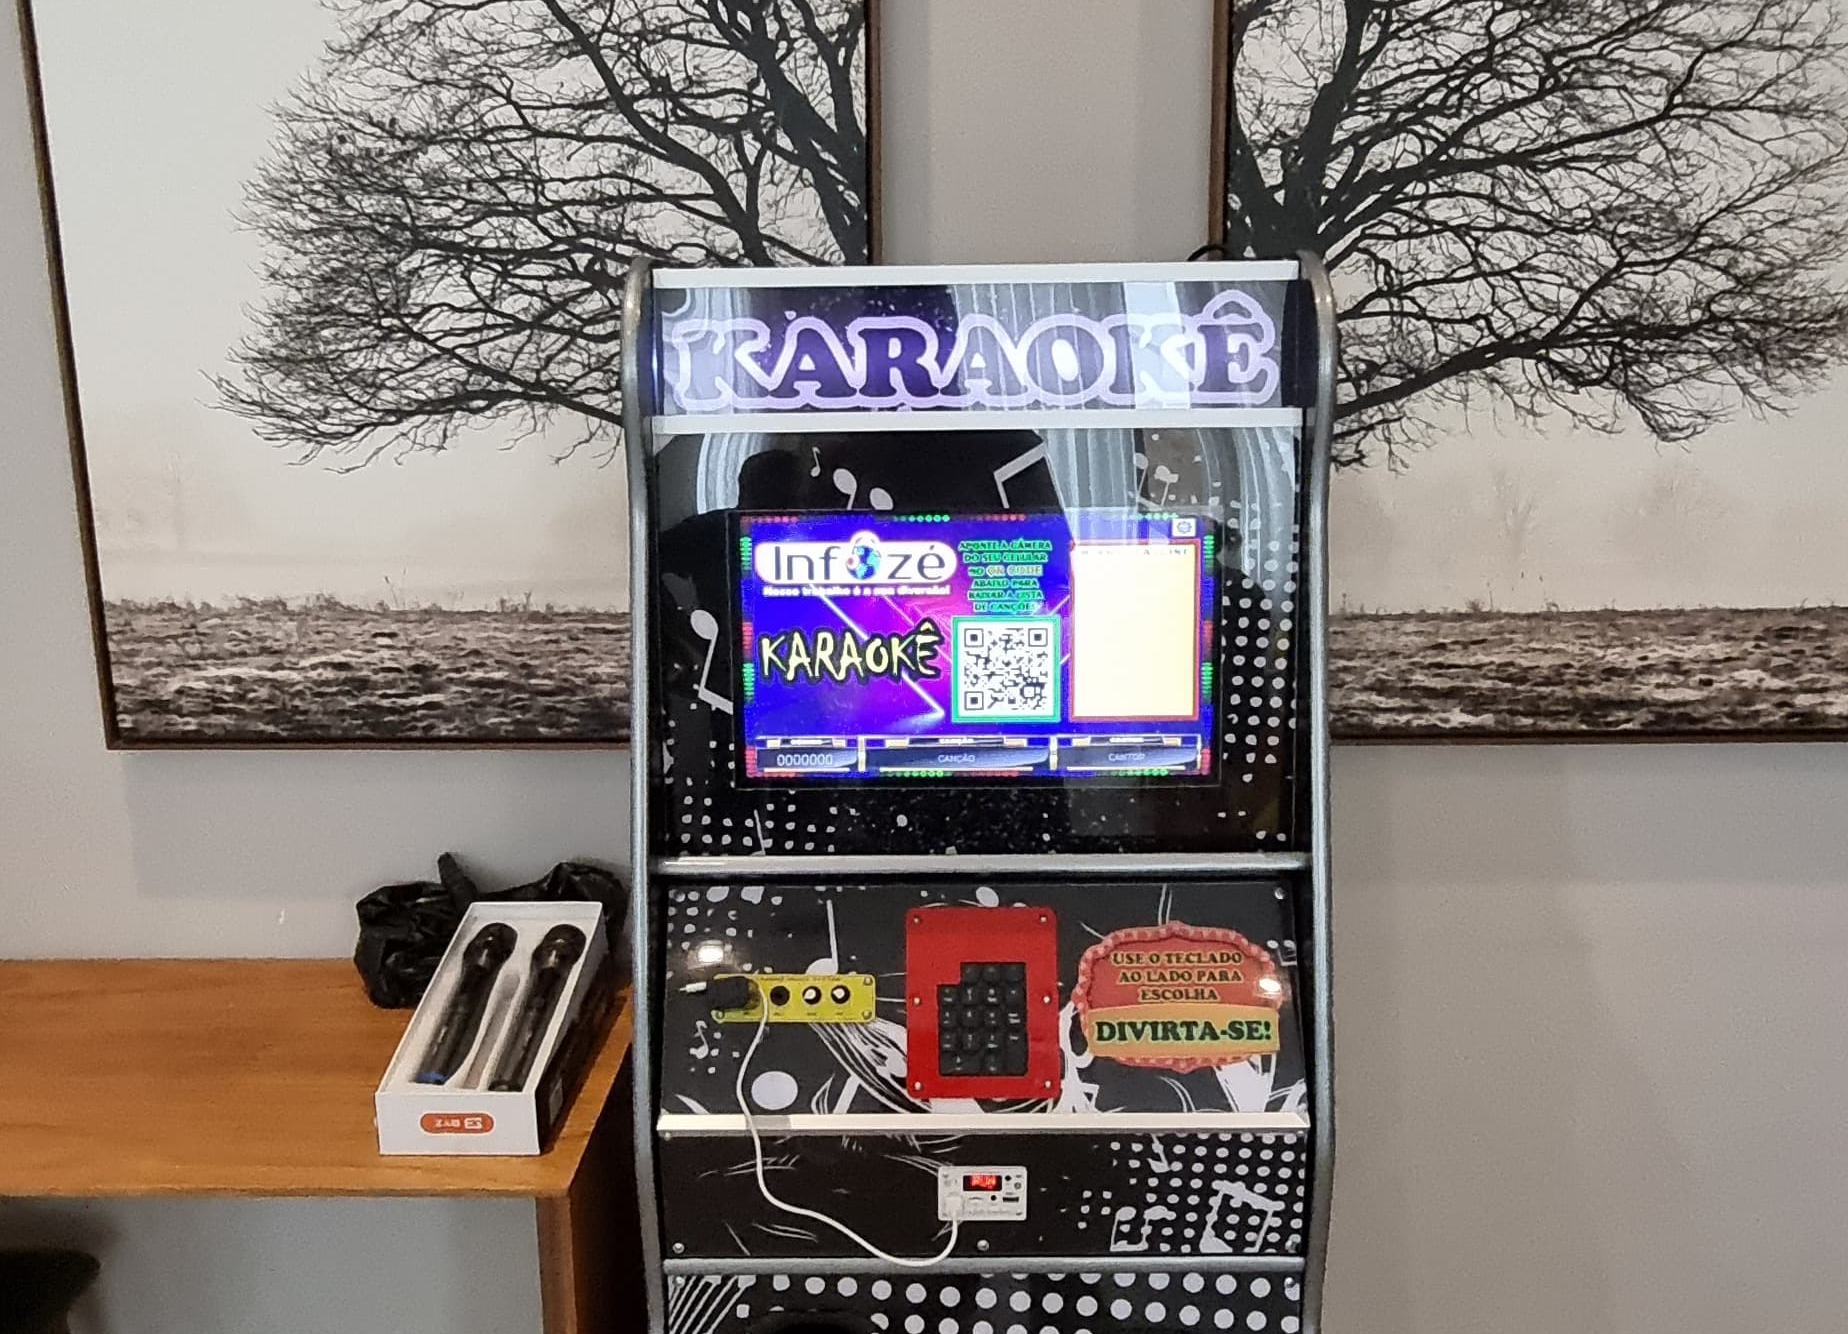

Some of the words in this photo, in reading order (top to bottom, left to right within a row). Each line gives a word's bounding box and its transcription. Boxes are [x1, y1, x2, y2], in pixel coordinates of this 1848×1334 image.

[672, 290, 1279, 409] KARAOKÊ
[963, 552, 981, 563] DO
[981, 552, 1002, 563] SEU
[1002, 552, 1048, 563] CELULAR
[757, 618, 943, 683] KARAOKÊ
[1112, 952, 1144, 965] USE
[1149, 952, 1161, 964] O
[1162, 951, 1243, 965] TECLADO
[1119, 971, 1142, 983] AO
[1146, 970, 1193, 983] LADO
[1197, 970, 1243, 983] PARA
[1140, 987, 1219, 1001] ESCOLHA
[1095, 1020, 1272, 1042] DIVIRTA-SE!
